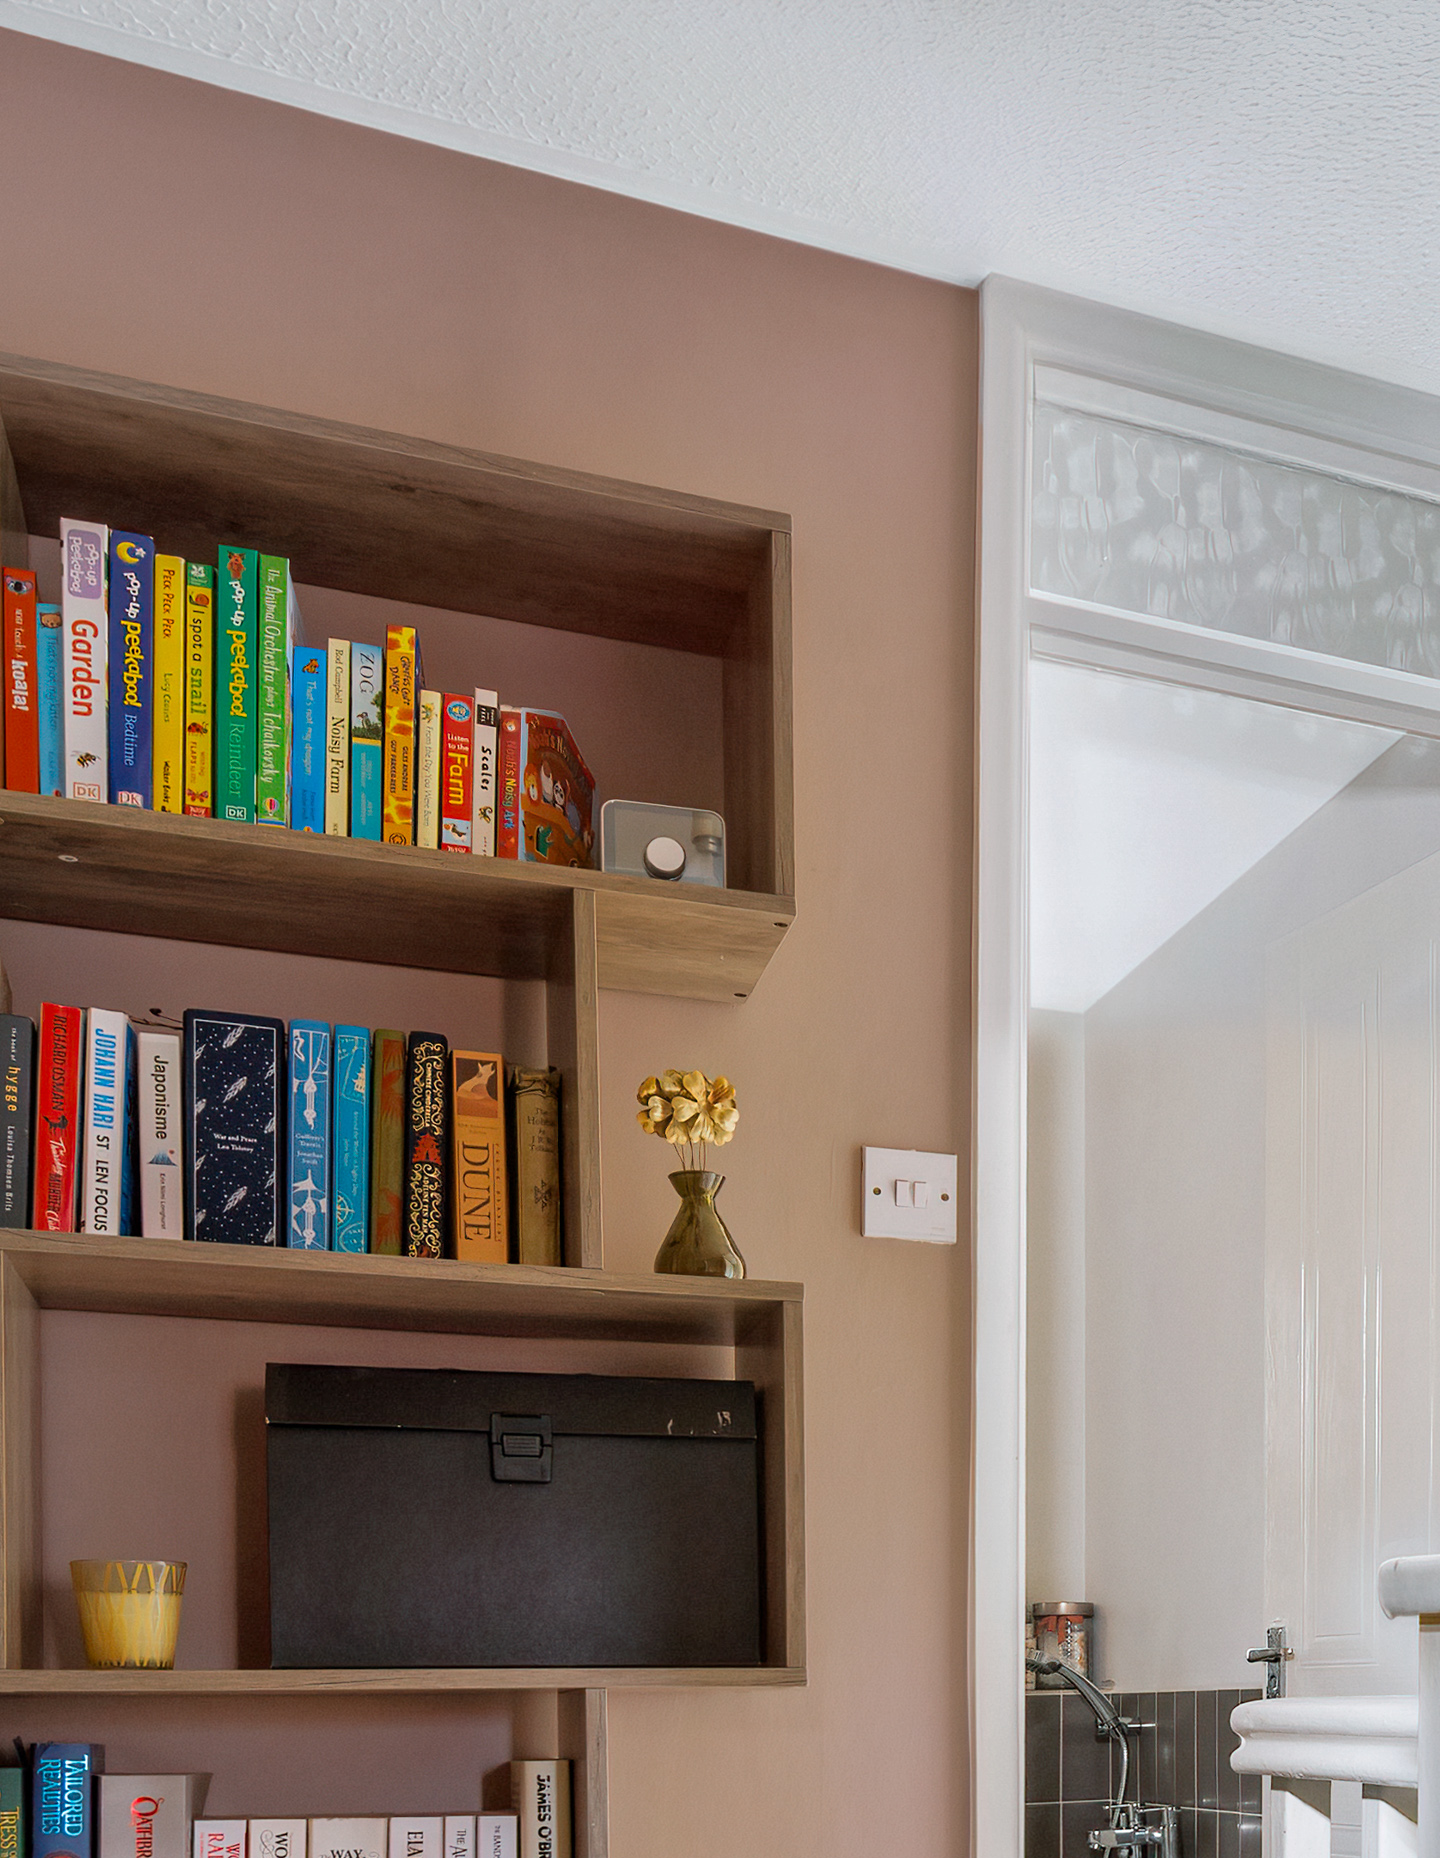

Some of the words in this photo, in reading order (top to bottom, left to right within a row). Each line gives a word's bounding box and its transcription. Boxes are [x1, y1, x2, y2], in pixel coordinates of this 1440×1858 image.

[68, 537, 83, 592] peekaboo!
[84, 543, 101, 586] pop-up
[162, 569, 176, 589] PECK
[122, 572, 142, 619] pop-up
[162, 593, 176, 613] PECK
[230, 582, 247, 627] pop-up
[162, 618, 176, 638] PECK
[70, 619, 101, 717] Garden
[120, 620, 144, 708] peekaboo!
[226, 630, 250, 718] peekaboo!
[334, 649, 345, 665] Rod
[359, 652, 376, 695] ZOG
[333, 667, 344, 704] Campbell
[122, 714, 138, 767] Bedtime
[328, 717, 345, 754] Noisy
[230, 724, 247, 798] Reindeer
[329, 759, 345, 795] Farm
[447, 752, 468, 805] Farm
[480, 746, 493, 791] Scales
[503, 777, 517, 806] Noisy
[504, 810, 516, 829] Ark
[51, 1015, 68, 1065] RICHARD
[93, 1028, 117, 1088] JOHANN
[51, 1067, 66, 1112] OSMAN
[92, 1093, 115, 1130] HARI
[151, 1054, 169, 1140] Japonisme
[6, 1126, 16, 1152] Louisa
[6, 1154, 16, 1190] Thomsen
[461, 1140, 492, 1242] DUNE
[37, 1758, 62, 1835] REALITIES
[61, 1754, 89, 1837] TAILORED
